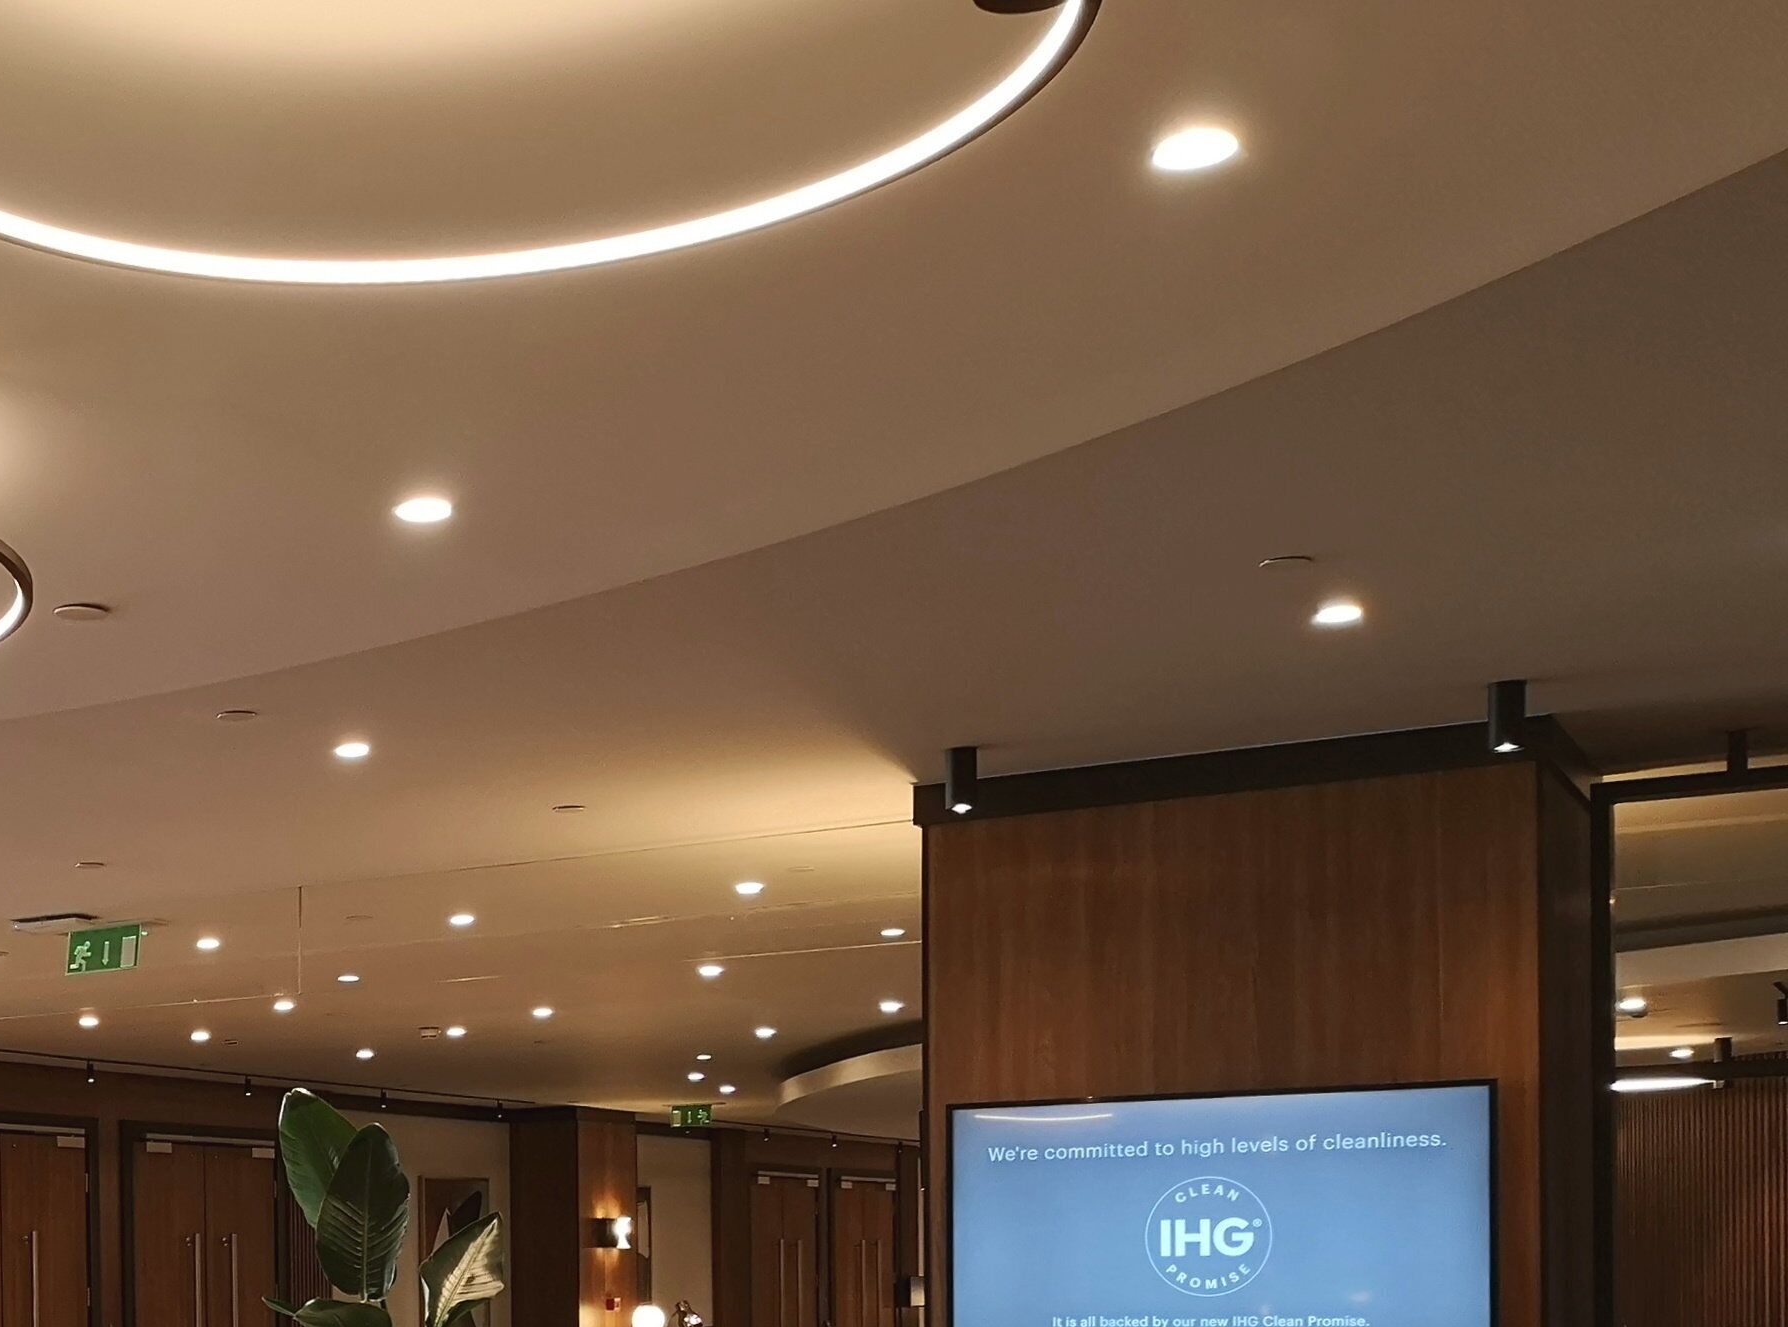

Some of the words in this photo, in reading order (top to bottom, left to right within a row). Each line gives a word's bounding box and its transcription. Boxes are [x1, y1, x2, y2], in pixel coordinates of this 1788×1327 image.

[987, 1146, 1039, 1162] We're
[1044, 1140, 1149, 1160] committed
[1155, 1142, 1175, 1157] to
[1181, 1138, 1225, 1158] high
[1231, 1135, 1289, 1154] levels
[1295, 1134, 1317, 1151] of
[1322, 1131, 1447, 1151] cleanliness.
[1174, 1183, 1240, 1203] CLEAN
[1165, 1263, 1251, 1290] PROMISE
[1052, 1316, 1063, 1327] It
[1065, 1316, 1077, 1327] is
[1080, 1315, 1096, 1327] all
[1099, 1315, 1149, 1327] backed
[1172, 1318, 1196, 1327] our
[1200, 1317, 1229, 1327] new
[1232, 1316, 1259, 1327] IHG
[1262, 1315, 1304, 1327] Clean
[1307, 1315, 1370, 1327] Promise.
